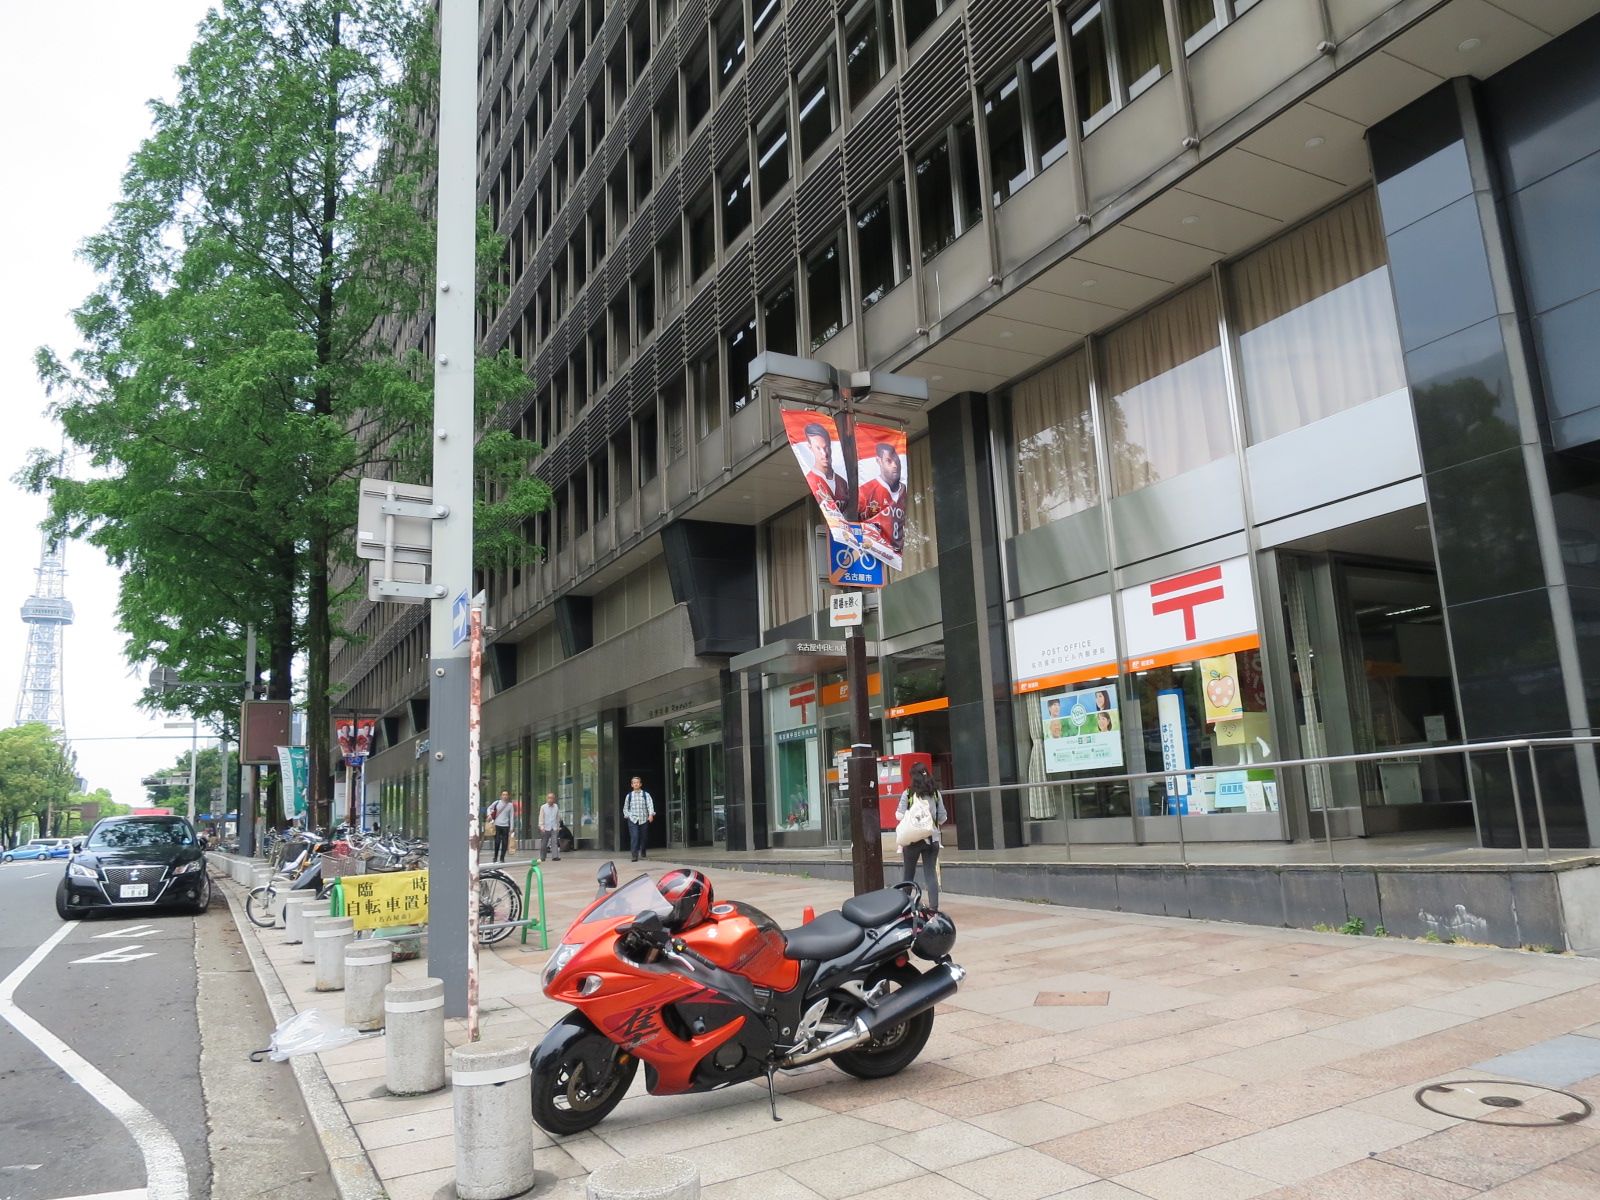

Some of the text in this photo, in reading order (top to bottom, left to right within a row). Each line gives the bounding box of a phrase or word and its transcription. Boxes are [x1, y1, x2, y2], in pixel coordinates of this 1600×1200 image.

[893, 521, 899, 540] 8
[844, 572, 873, 582] 名古屋市
[1042, 640, 1091, 656] POST OFFICE
